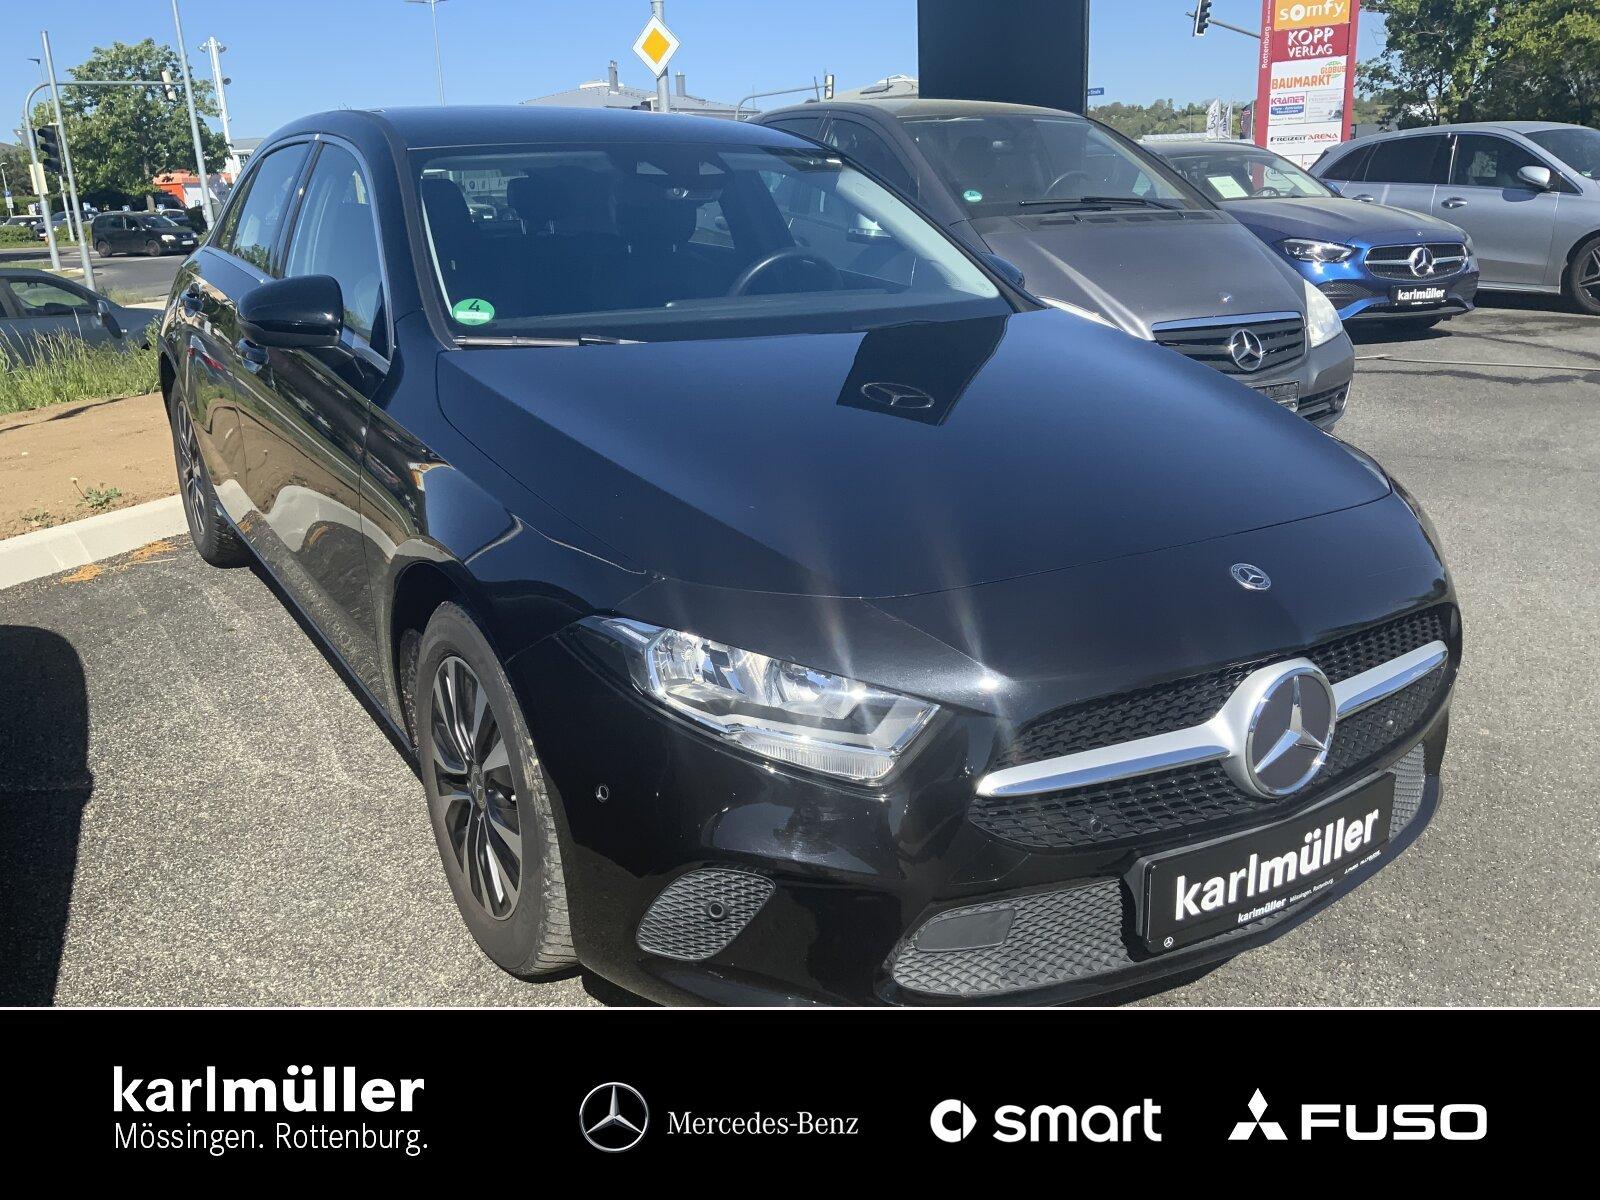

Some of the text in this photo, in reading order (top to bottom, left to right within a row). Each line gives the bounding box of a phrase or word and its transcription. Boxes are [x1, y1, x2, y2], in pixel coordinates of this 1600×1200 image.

[1280, 0, 1344, 21] somfy
[1288, 27, 1334, 46] KOPP
[1262, 26, 1271, 68] Rottenburg
[1288, 43, 1333, 58] VERLAG
[1321, 65, 1347, 74] GLOBUS
[1271, 74, 1332, 90] BAUMARKT
[1397, 287, 1446, 301] karlmüller
[468, 300, 480, 312] 4
[1175, 808, 1379, 921] karlmüller
[1237, 898, 1287, 923] karlmüller
